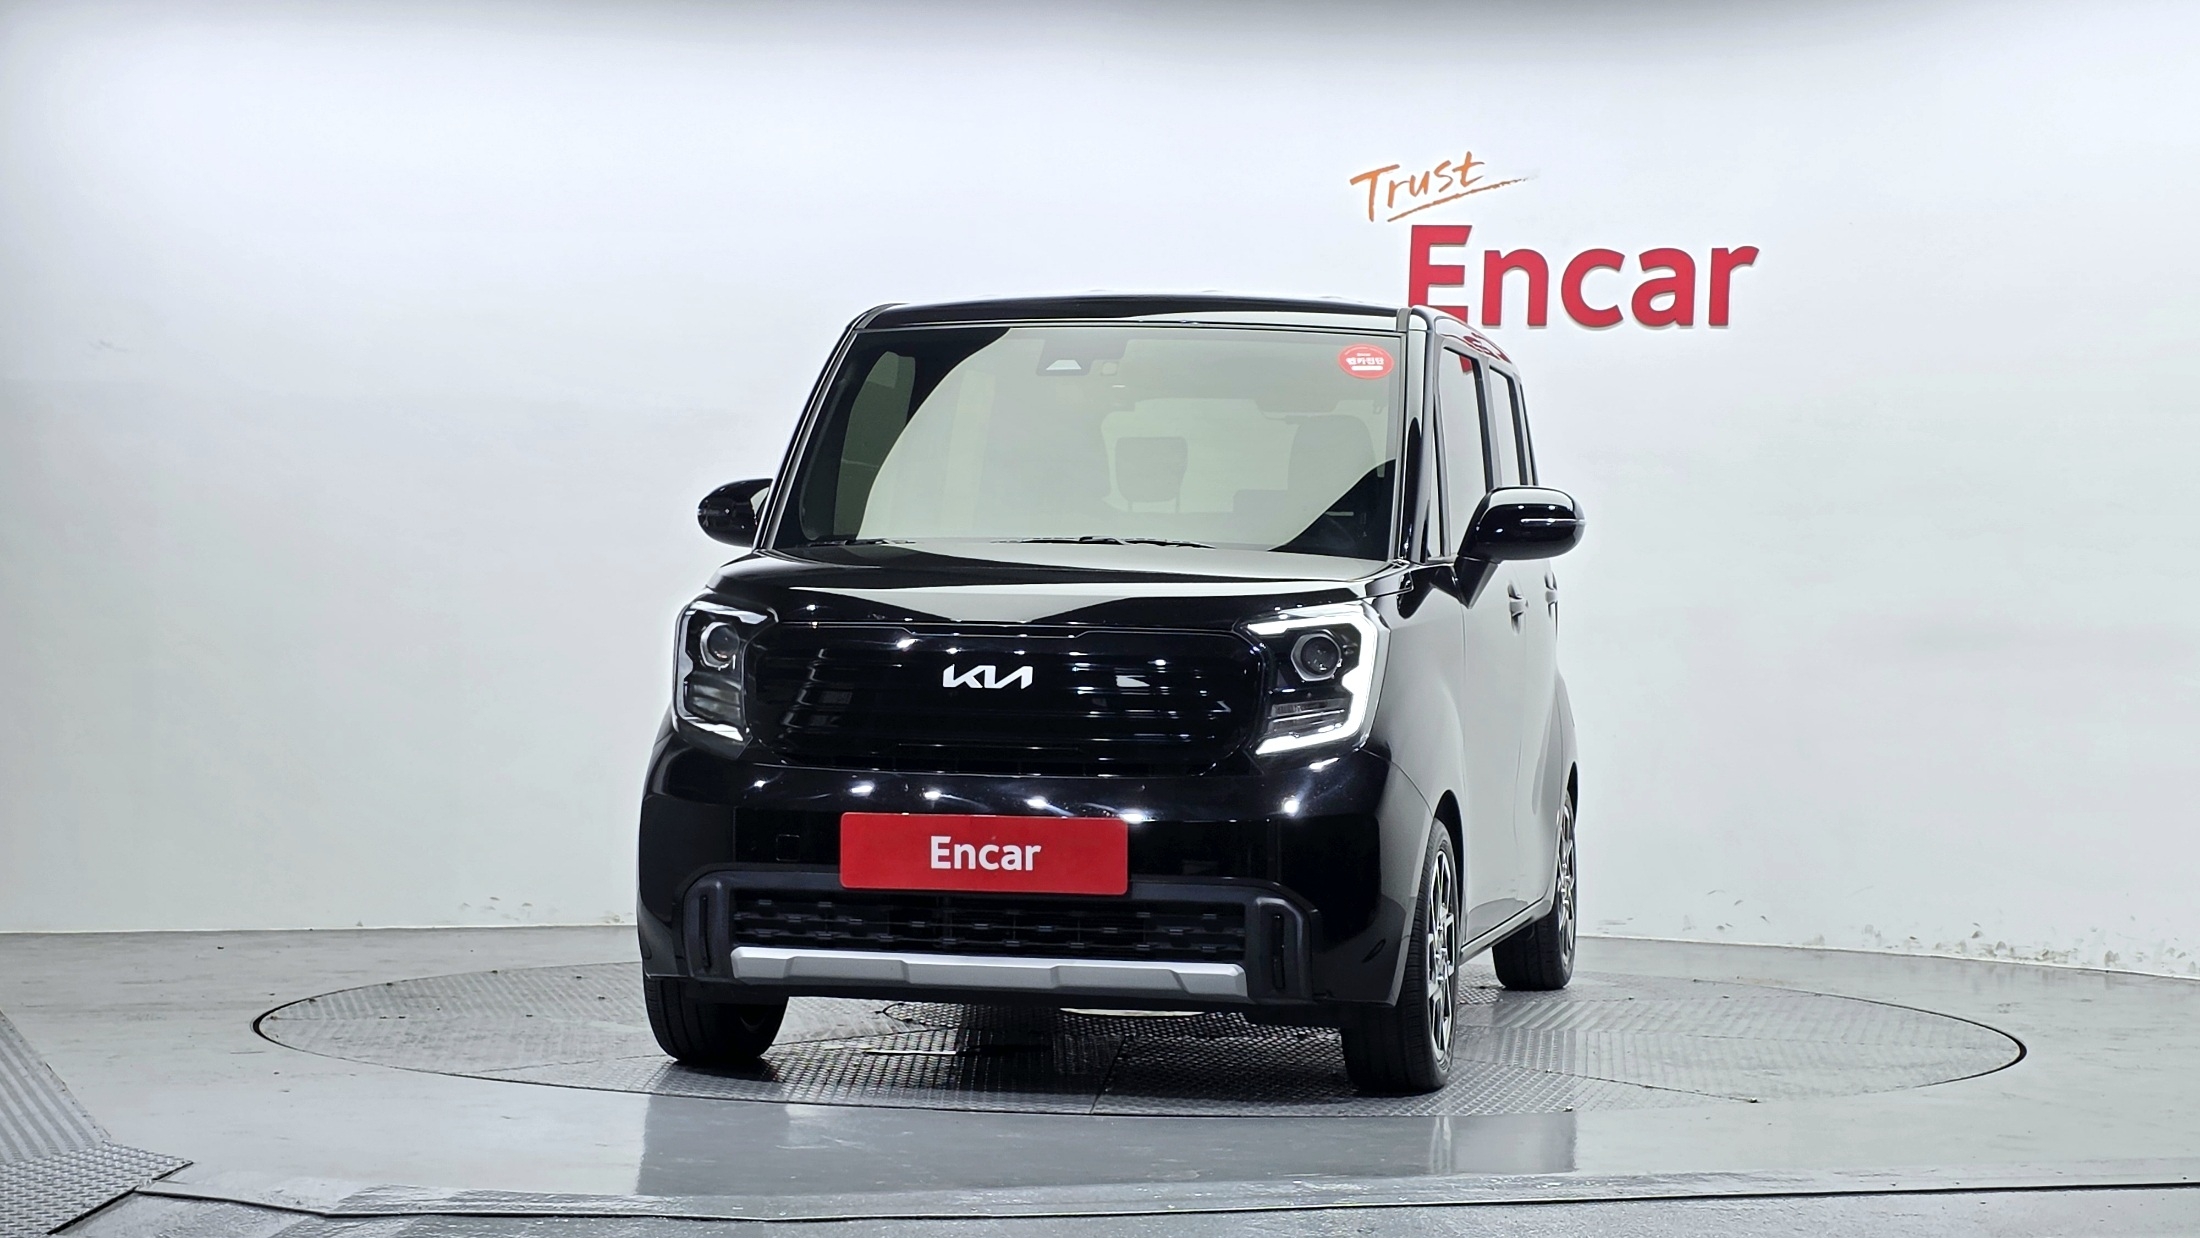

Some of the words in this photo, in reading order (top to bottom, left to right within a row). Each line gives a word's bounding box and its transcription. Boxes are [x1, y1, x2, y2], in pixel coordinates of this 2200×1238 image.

[1350, 151, 1485, 222] Trust
[1408, 225, 1759, 328] Encar
[943, 664, 1033, 689] KIA
[930, 835, 1042, 871] Encar
